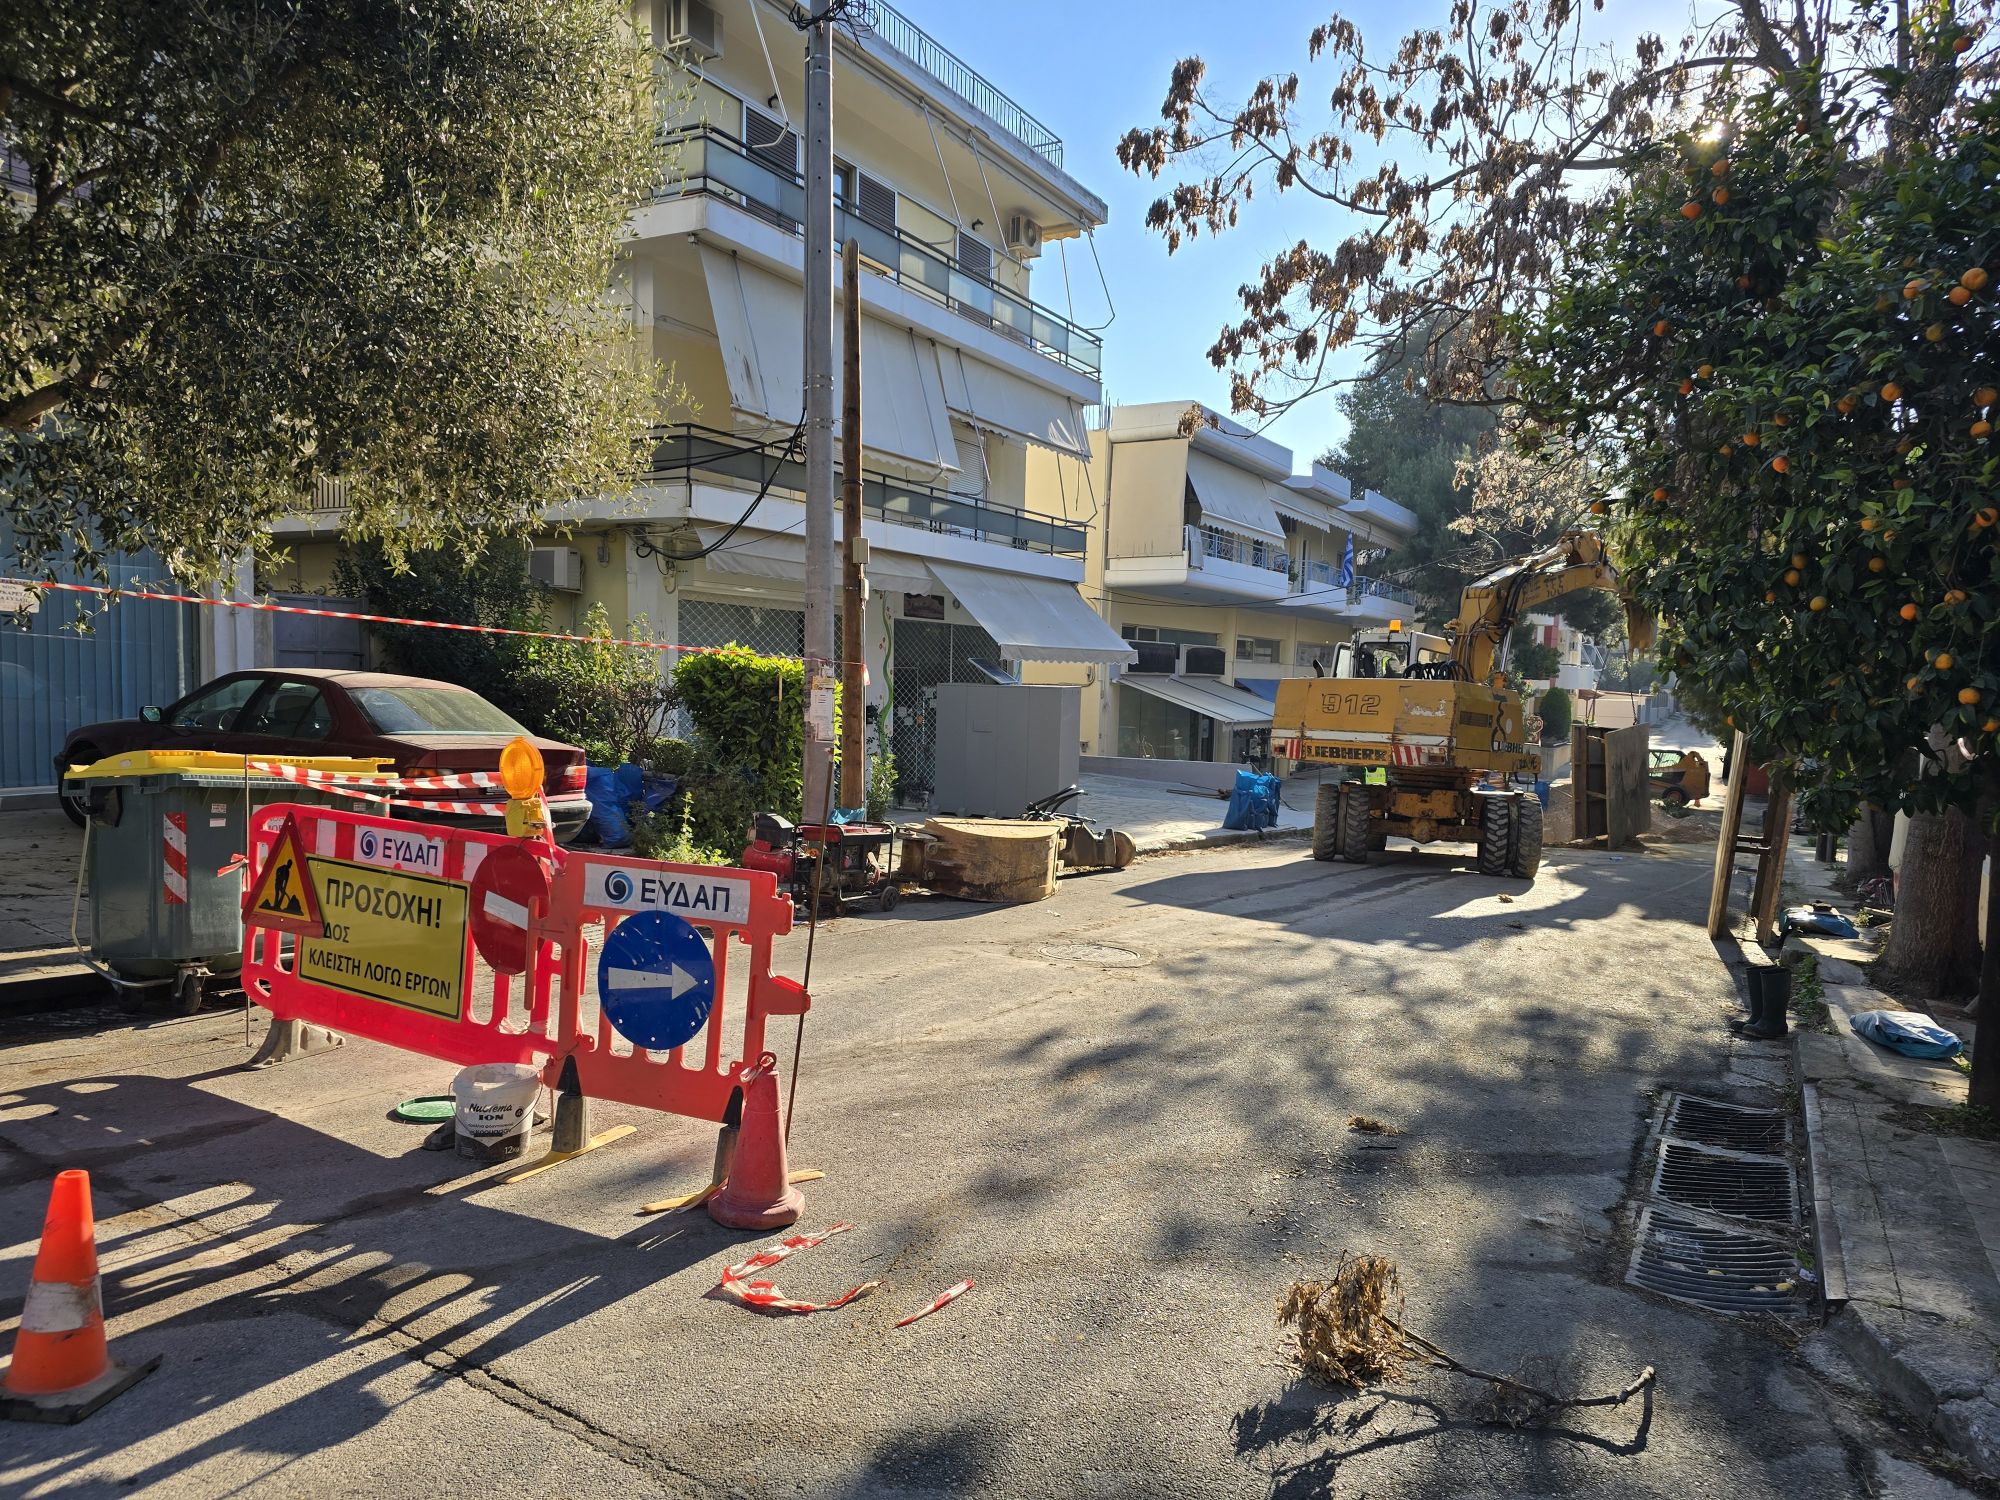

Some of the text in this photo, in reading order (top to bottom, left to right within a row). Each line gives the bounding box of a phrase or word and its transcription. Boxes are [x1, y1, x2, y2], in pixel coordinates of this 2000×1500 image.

[1322, 693, 1380, 716] 912
[382, 837, 438, 867] ΕΥΔΑΠ
[326, 878, 442, 928] ΠΡΟΣΟΧΗ!
[640, 878, 730, 912] ΕΥΔΑΠ
[324, 922, 350, 943] ΔΟΣ
[309, 947, 451, 1000] ΚΛΕΙΣΤΗ ΛΟΓΩ ΕΡΓΩΝ
